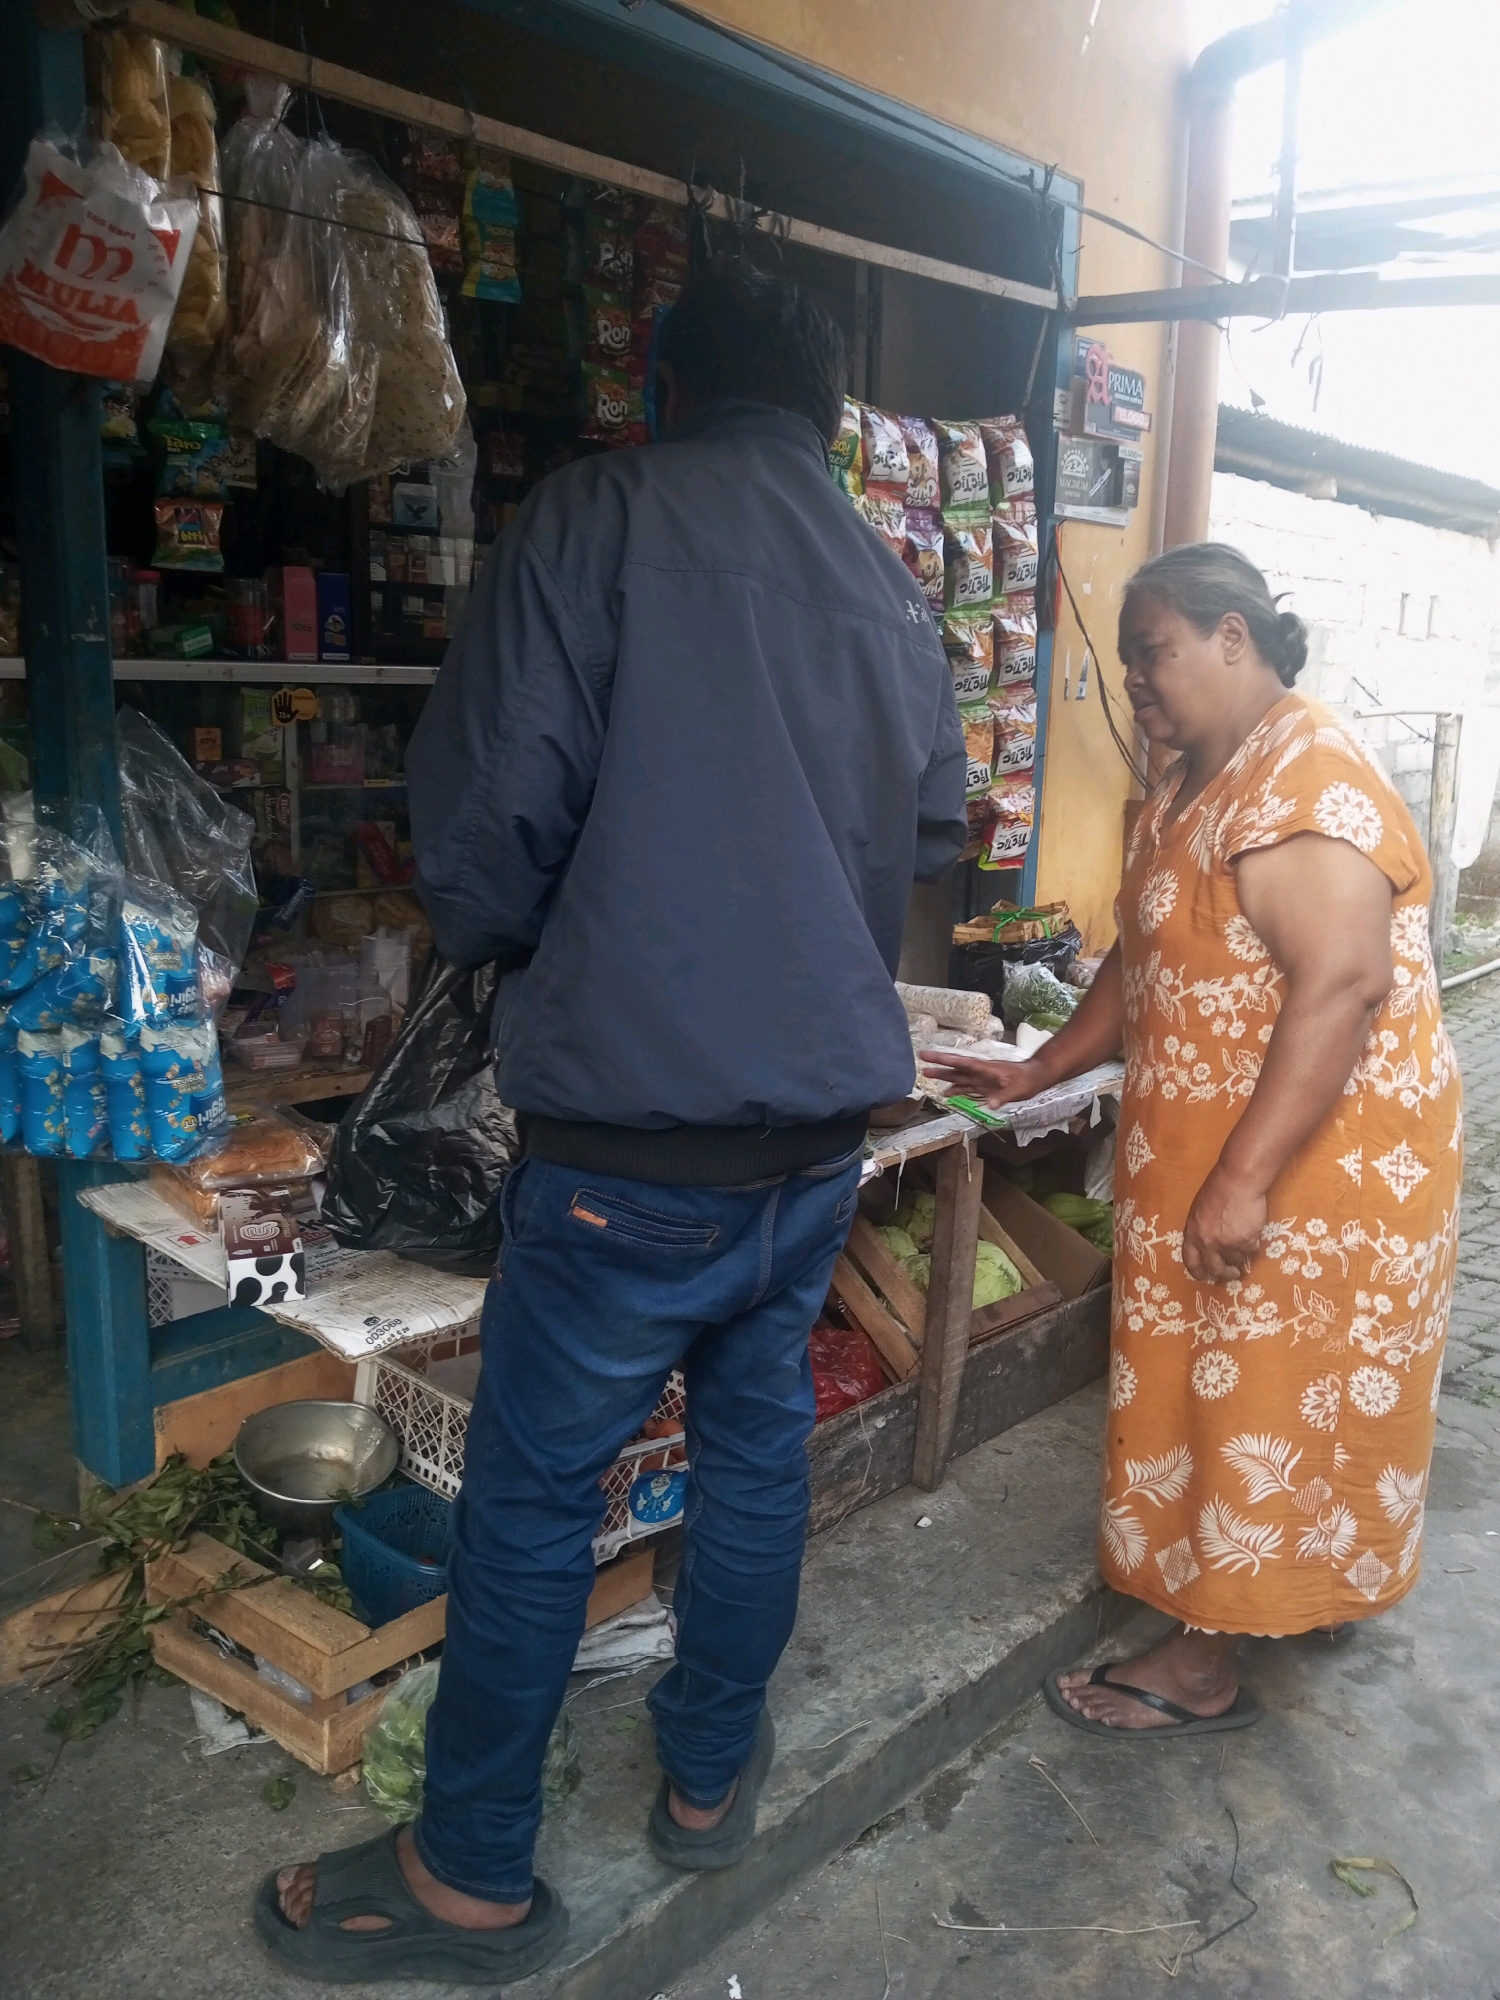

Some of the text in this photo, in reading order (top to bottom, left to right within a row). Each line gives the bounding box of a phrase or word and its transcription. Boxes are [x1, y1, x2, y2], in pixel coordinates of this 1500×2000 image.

[16, 259, 141, 325] MULIA
[1108, 371, 1144, 398] PRIMA
[597, 393, 628, 423] Ron
[164, 435, 202, 450] Taro
[831, 441, 851, 455] Ros
[828, 455, 850, 467] garu
[1059, 477, 1089, 491] MAGNUM
